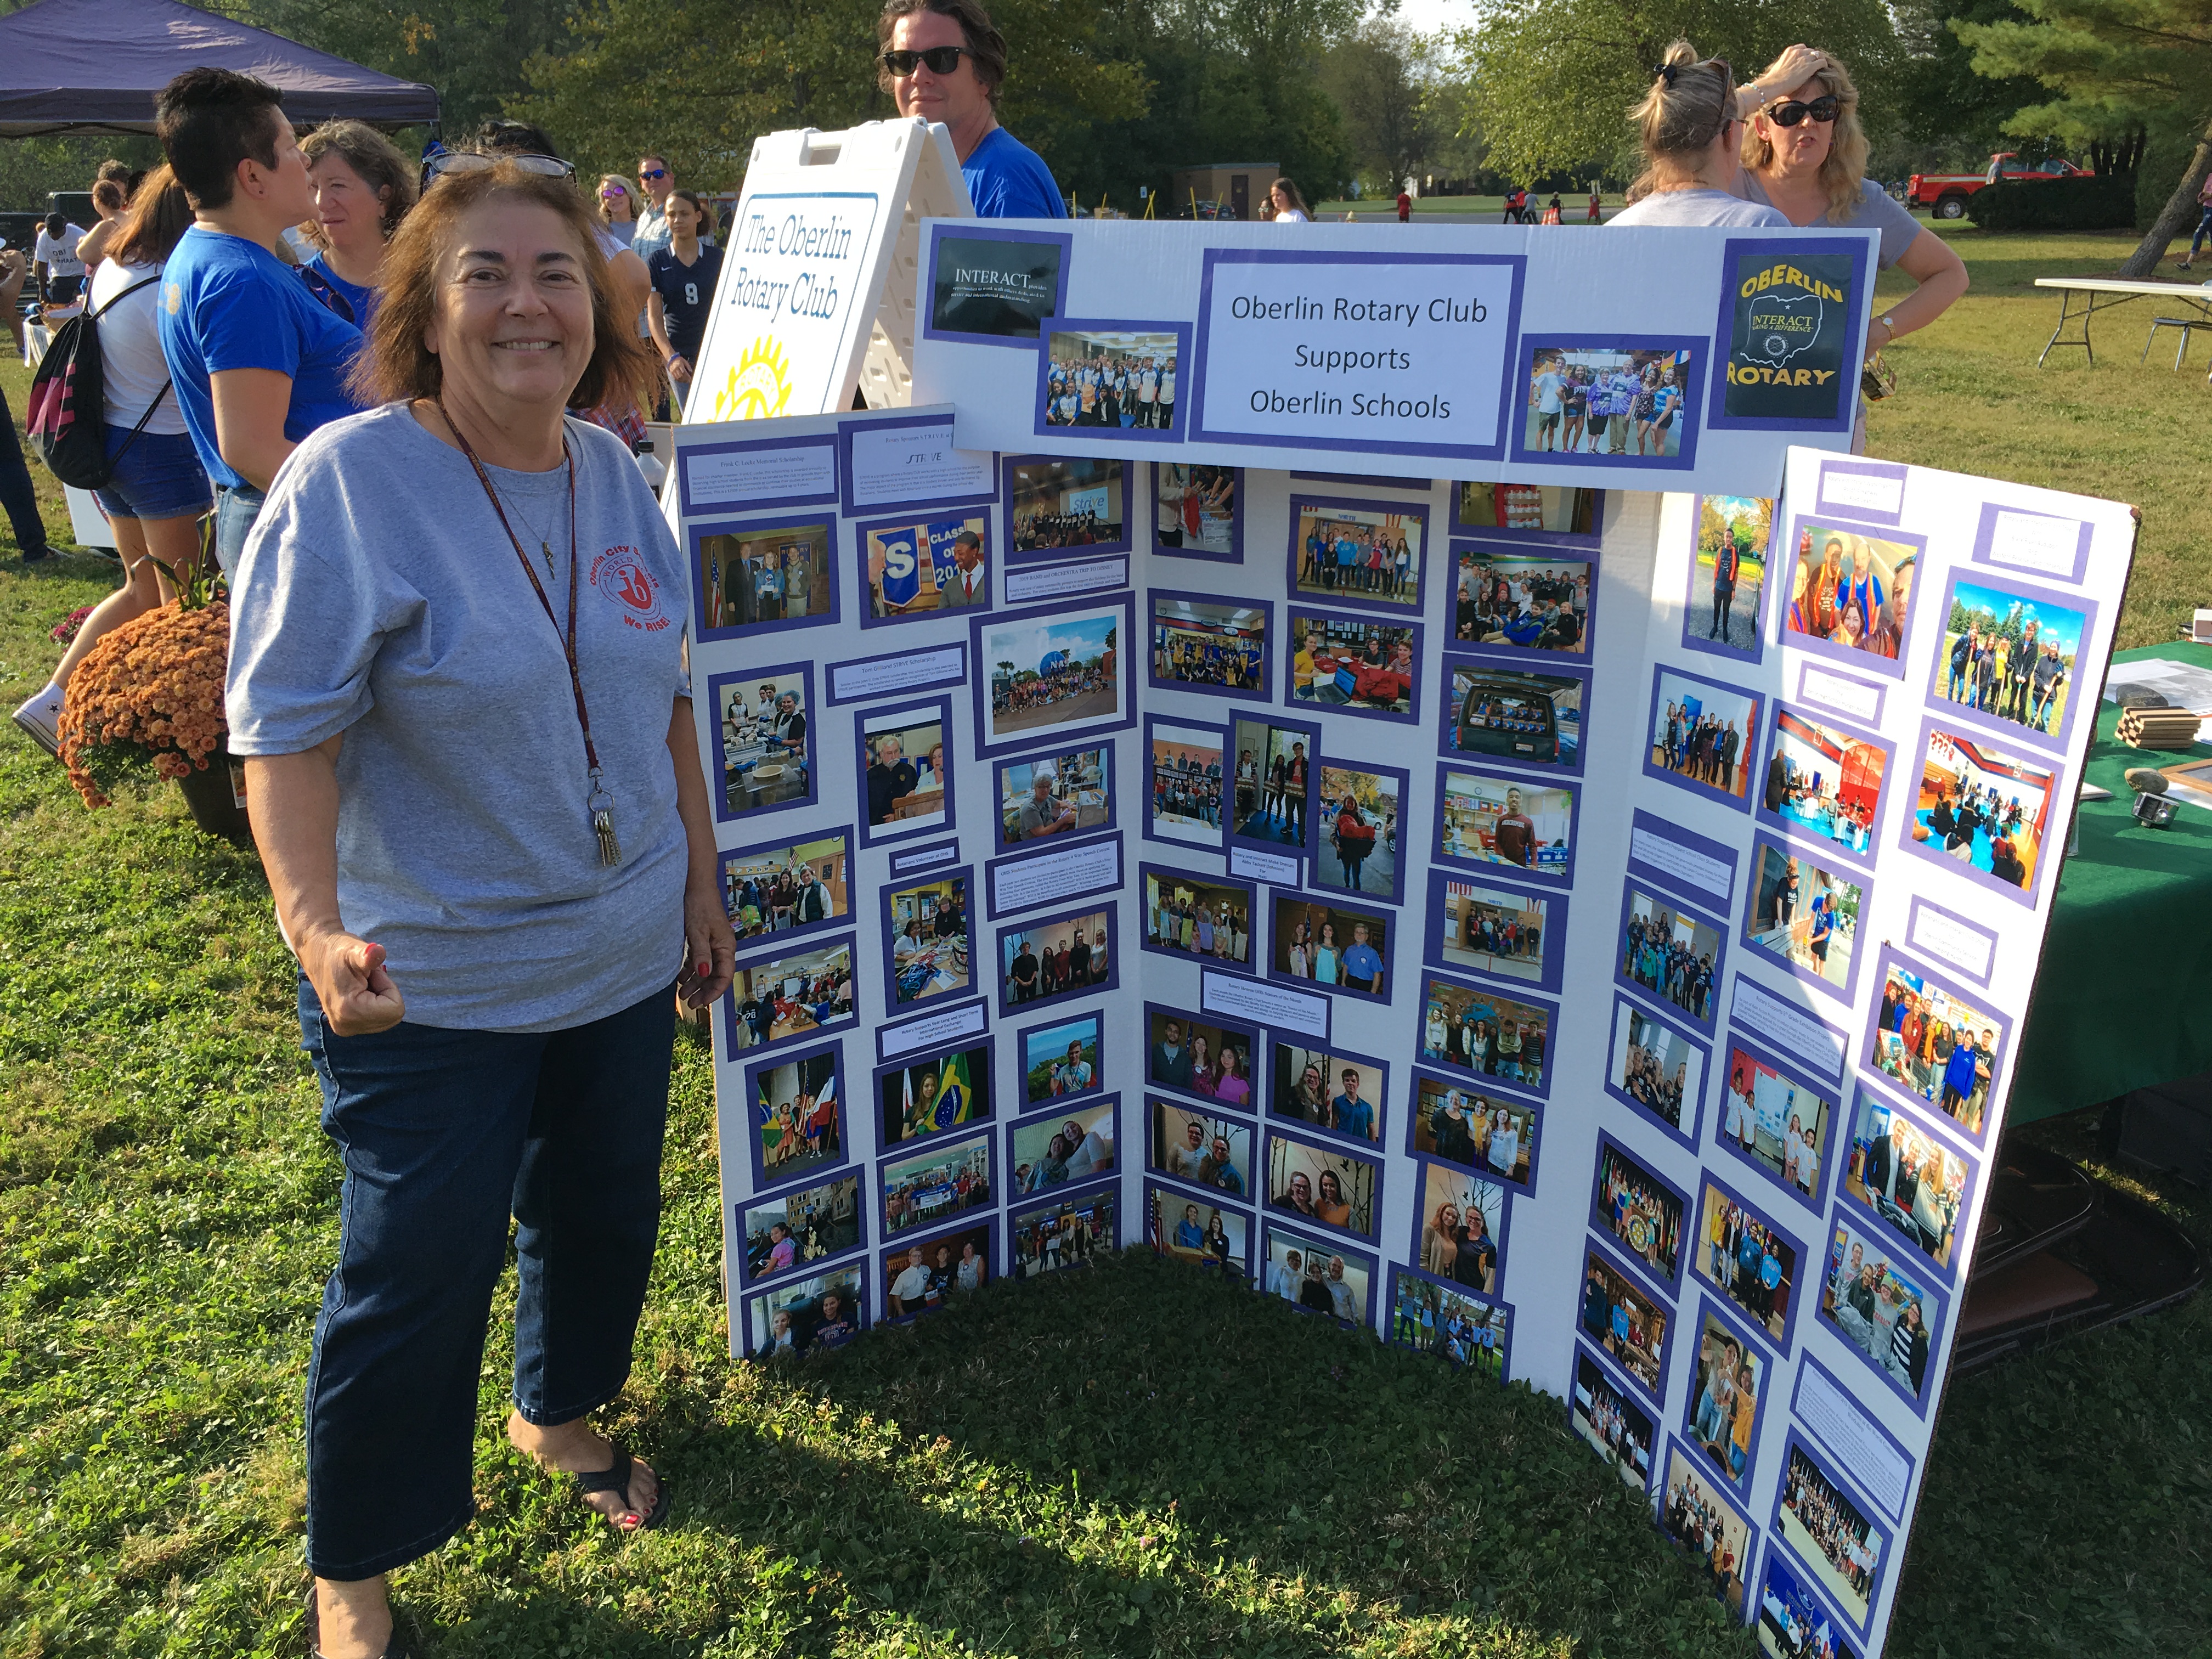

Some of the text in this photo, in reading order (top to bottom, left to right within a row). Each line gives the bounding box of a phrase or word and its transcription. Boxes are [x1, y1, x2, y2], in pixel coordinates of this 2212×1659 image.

[745, 214, 851, 259] The Oberlin
[955, 268, 1031, 288] INTERACT
[1741, 264, 1843, 303] OBERLIN
[685, 283, 699, 305] 9
[731, 267, 838, 323] Rotary Club
[1232, 295, 1487, 328] Oberlin Rotary Club
[1752, 314, 1813, 327] INTERACT
[1295, 345, 1410, 374] Supports
[1726, 360, 1836, 386] ROTARY
[1250, 390, 1451, 420] Oberlin Schools
[1074, 496, 1104, 510] Strive
[930, 526, 965, 544] CLASS
[590, 555, 606, 586] Oberlin
[605, 545, 629, 556] City
[603, 556, 633, 577] WORLD
[885, 541, 915, 579] S
[624, 614, 642, 630] We
